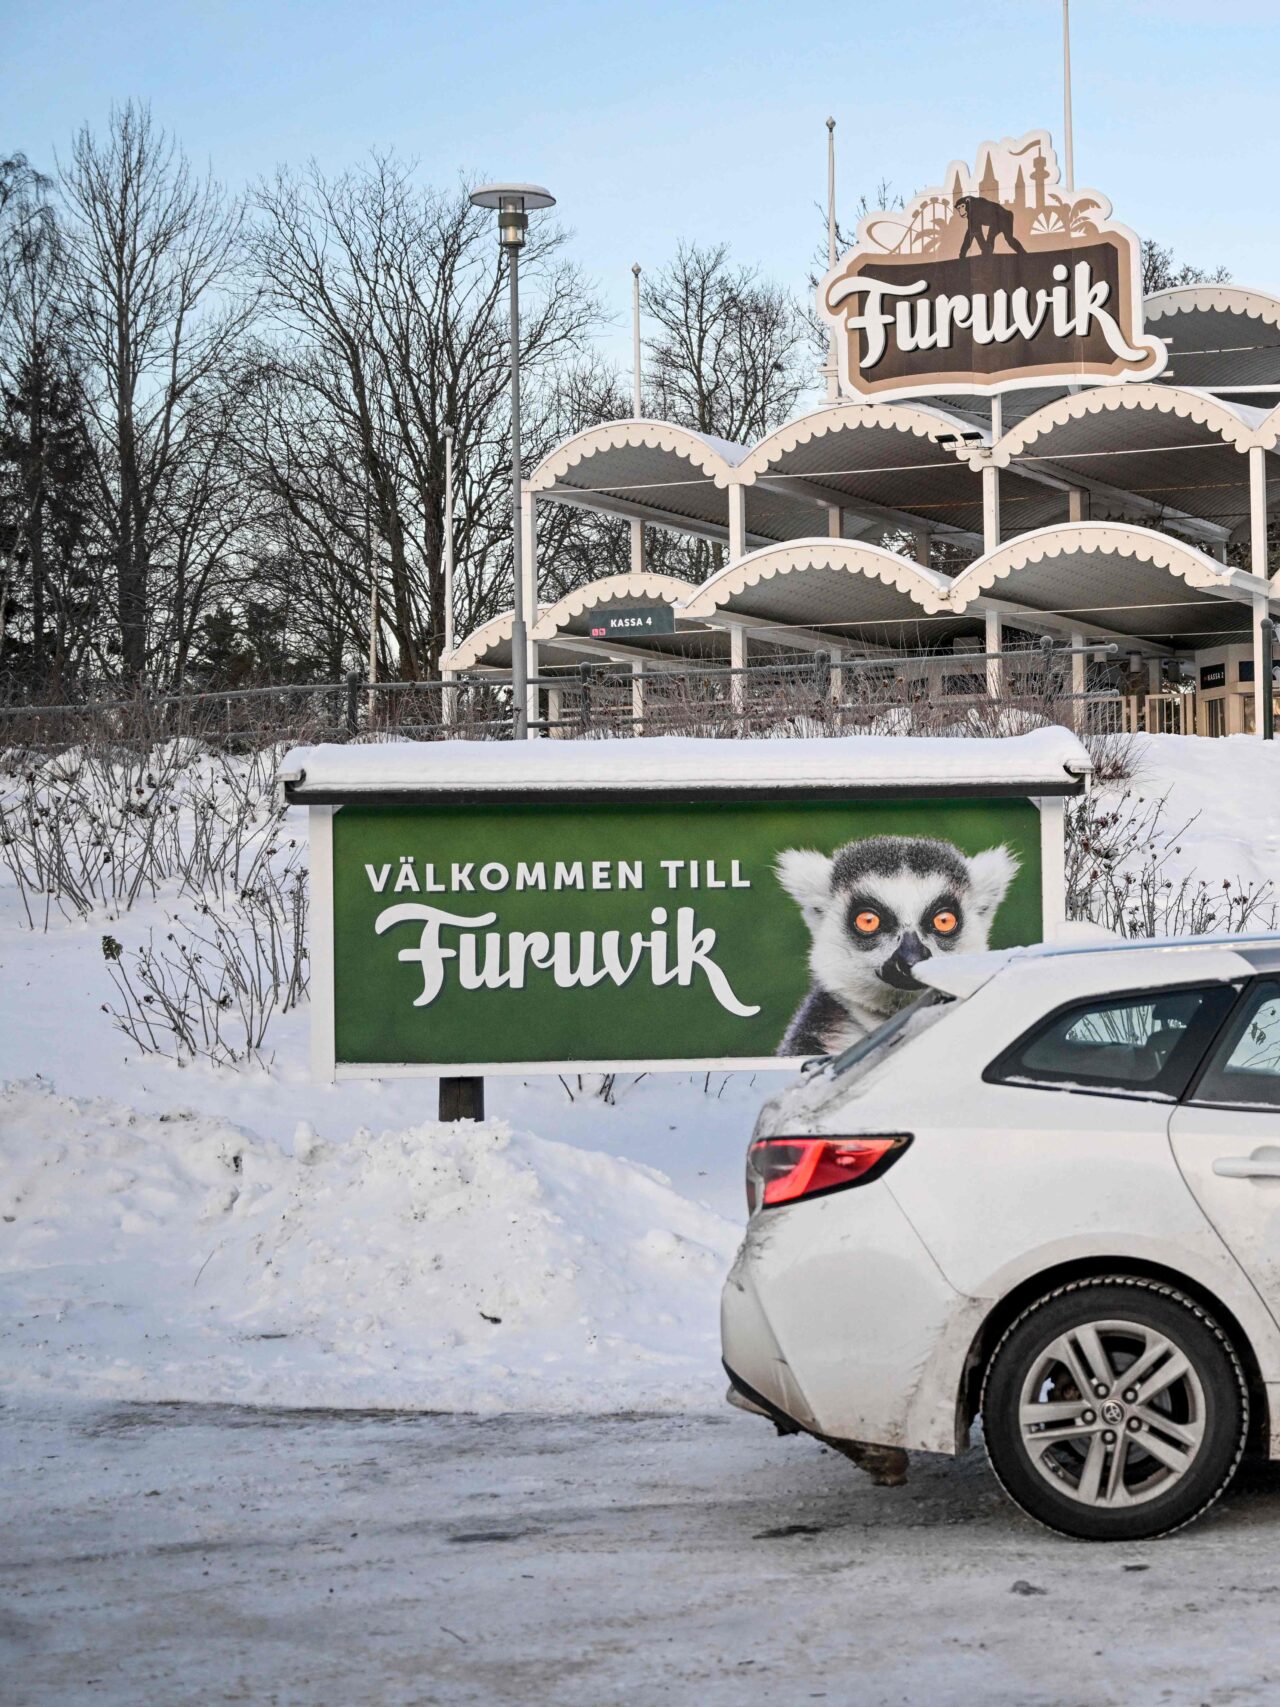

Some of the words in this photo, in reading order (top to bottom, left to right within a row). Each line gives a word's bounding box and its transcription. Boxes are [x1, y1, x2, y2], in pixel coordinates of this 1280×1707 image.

[828, 260, 1148, 368] Furuvik
[610, 618, 643, 628] KASSA
[645, 616, 653, 626] 4
[363, 856, 643, 892] VÄLKOMMEN
[660, 859, 751, 889] TILL
[375, 902, 761, 1017] Furuvik
